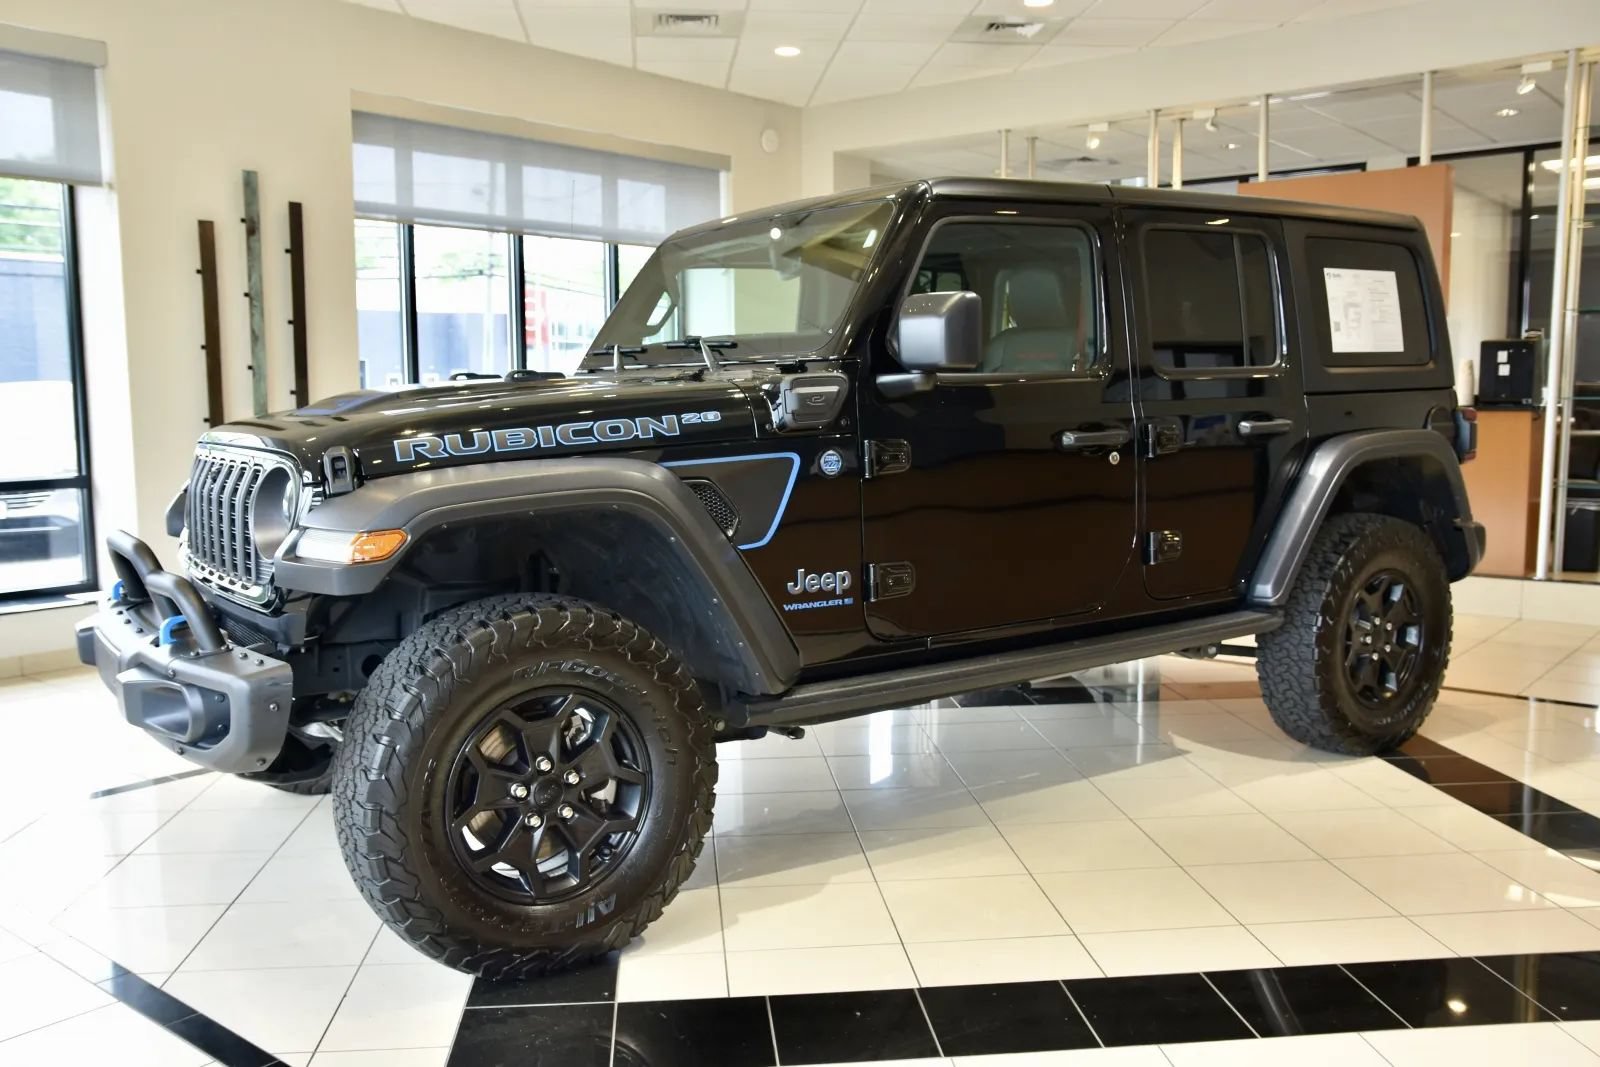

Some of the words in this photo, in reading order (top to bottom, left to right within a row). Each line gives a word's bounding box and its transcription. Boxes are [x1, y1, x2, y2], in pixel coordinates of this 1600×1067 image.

[394, 415, 680, 462] RUBICON
[787, 568, 852, 595] Jeep
[783, 598, 843, 611] WRANGLER
